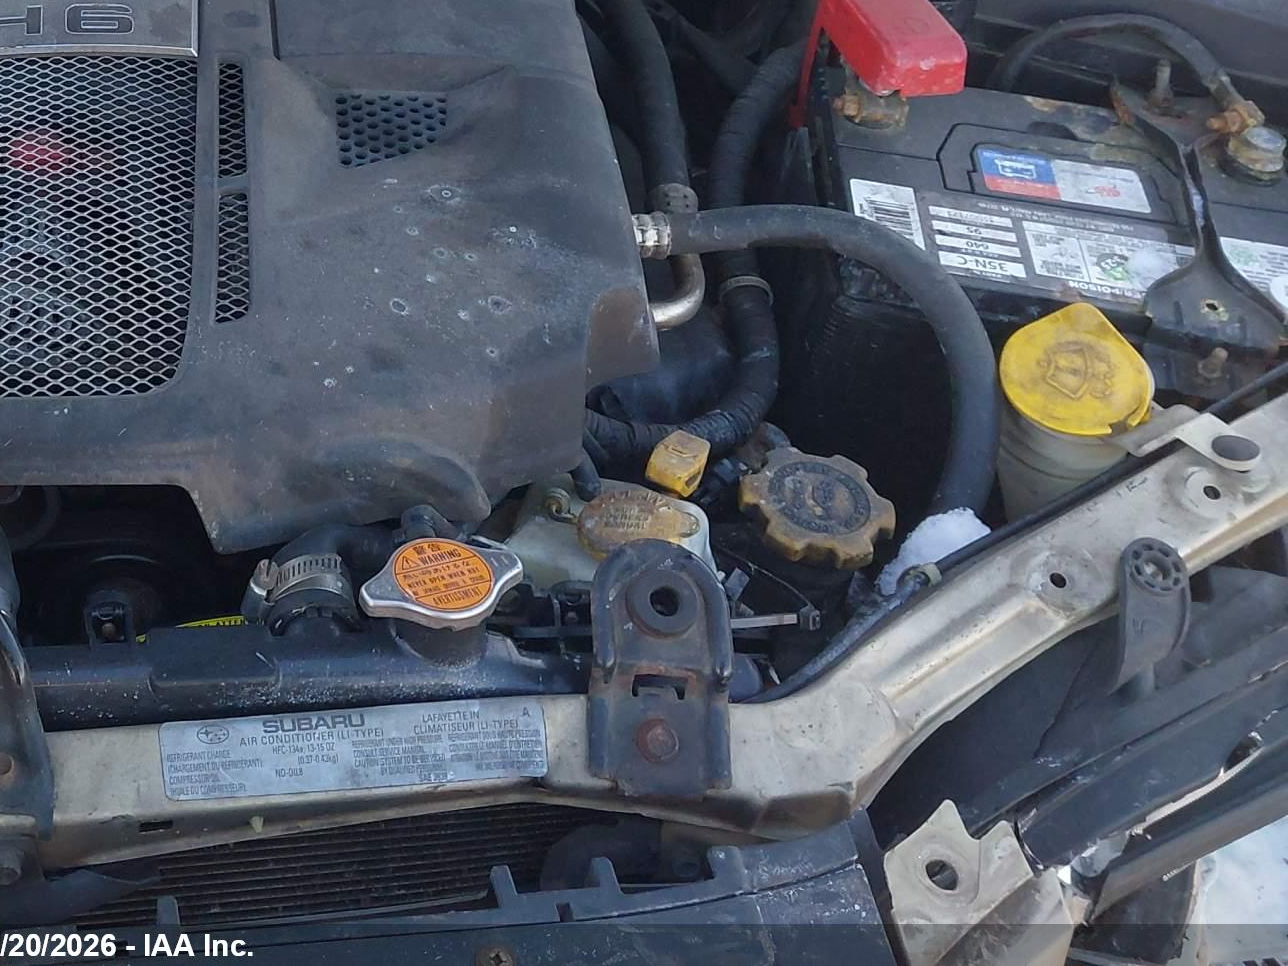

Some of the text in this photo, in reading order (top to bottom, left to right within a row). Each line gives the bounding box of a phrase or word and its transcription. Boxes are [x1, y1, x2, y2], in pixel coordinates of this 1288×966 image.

[965, 240, 989, 250] 640
[956, 255, 1008, 272] 35N-C
[418, 547, 462, 566] WARNING
[407, 579, 427, 588] NEVER
[429, 575, 446, 584] OPEN
[448, 571, 467, 580] WHEN
[262, 713, 365, 734] SUBARU
[413, 720, 475, 735] CLIMATISEUR
[239, 736, 258, 747] AIR
[261, 728, 334, 746] CONDITIONER
